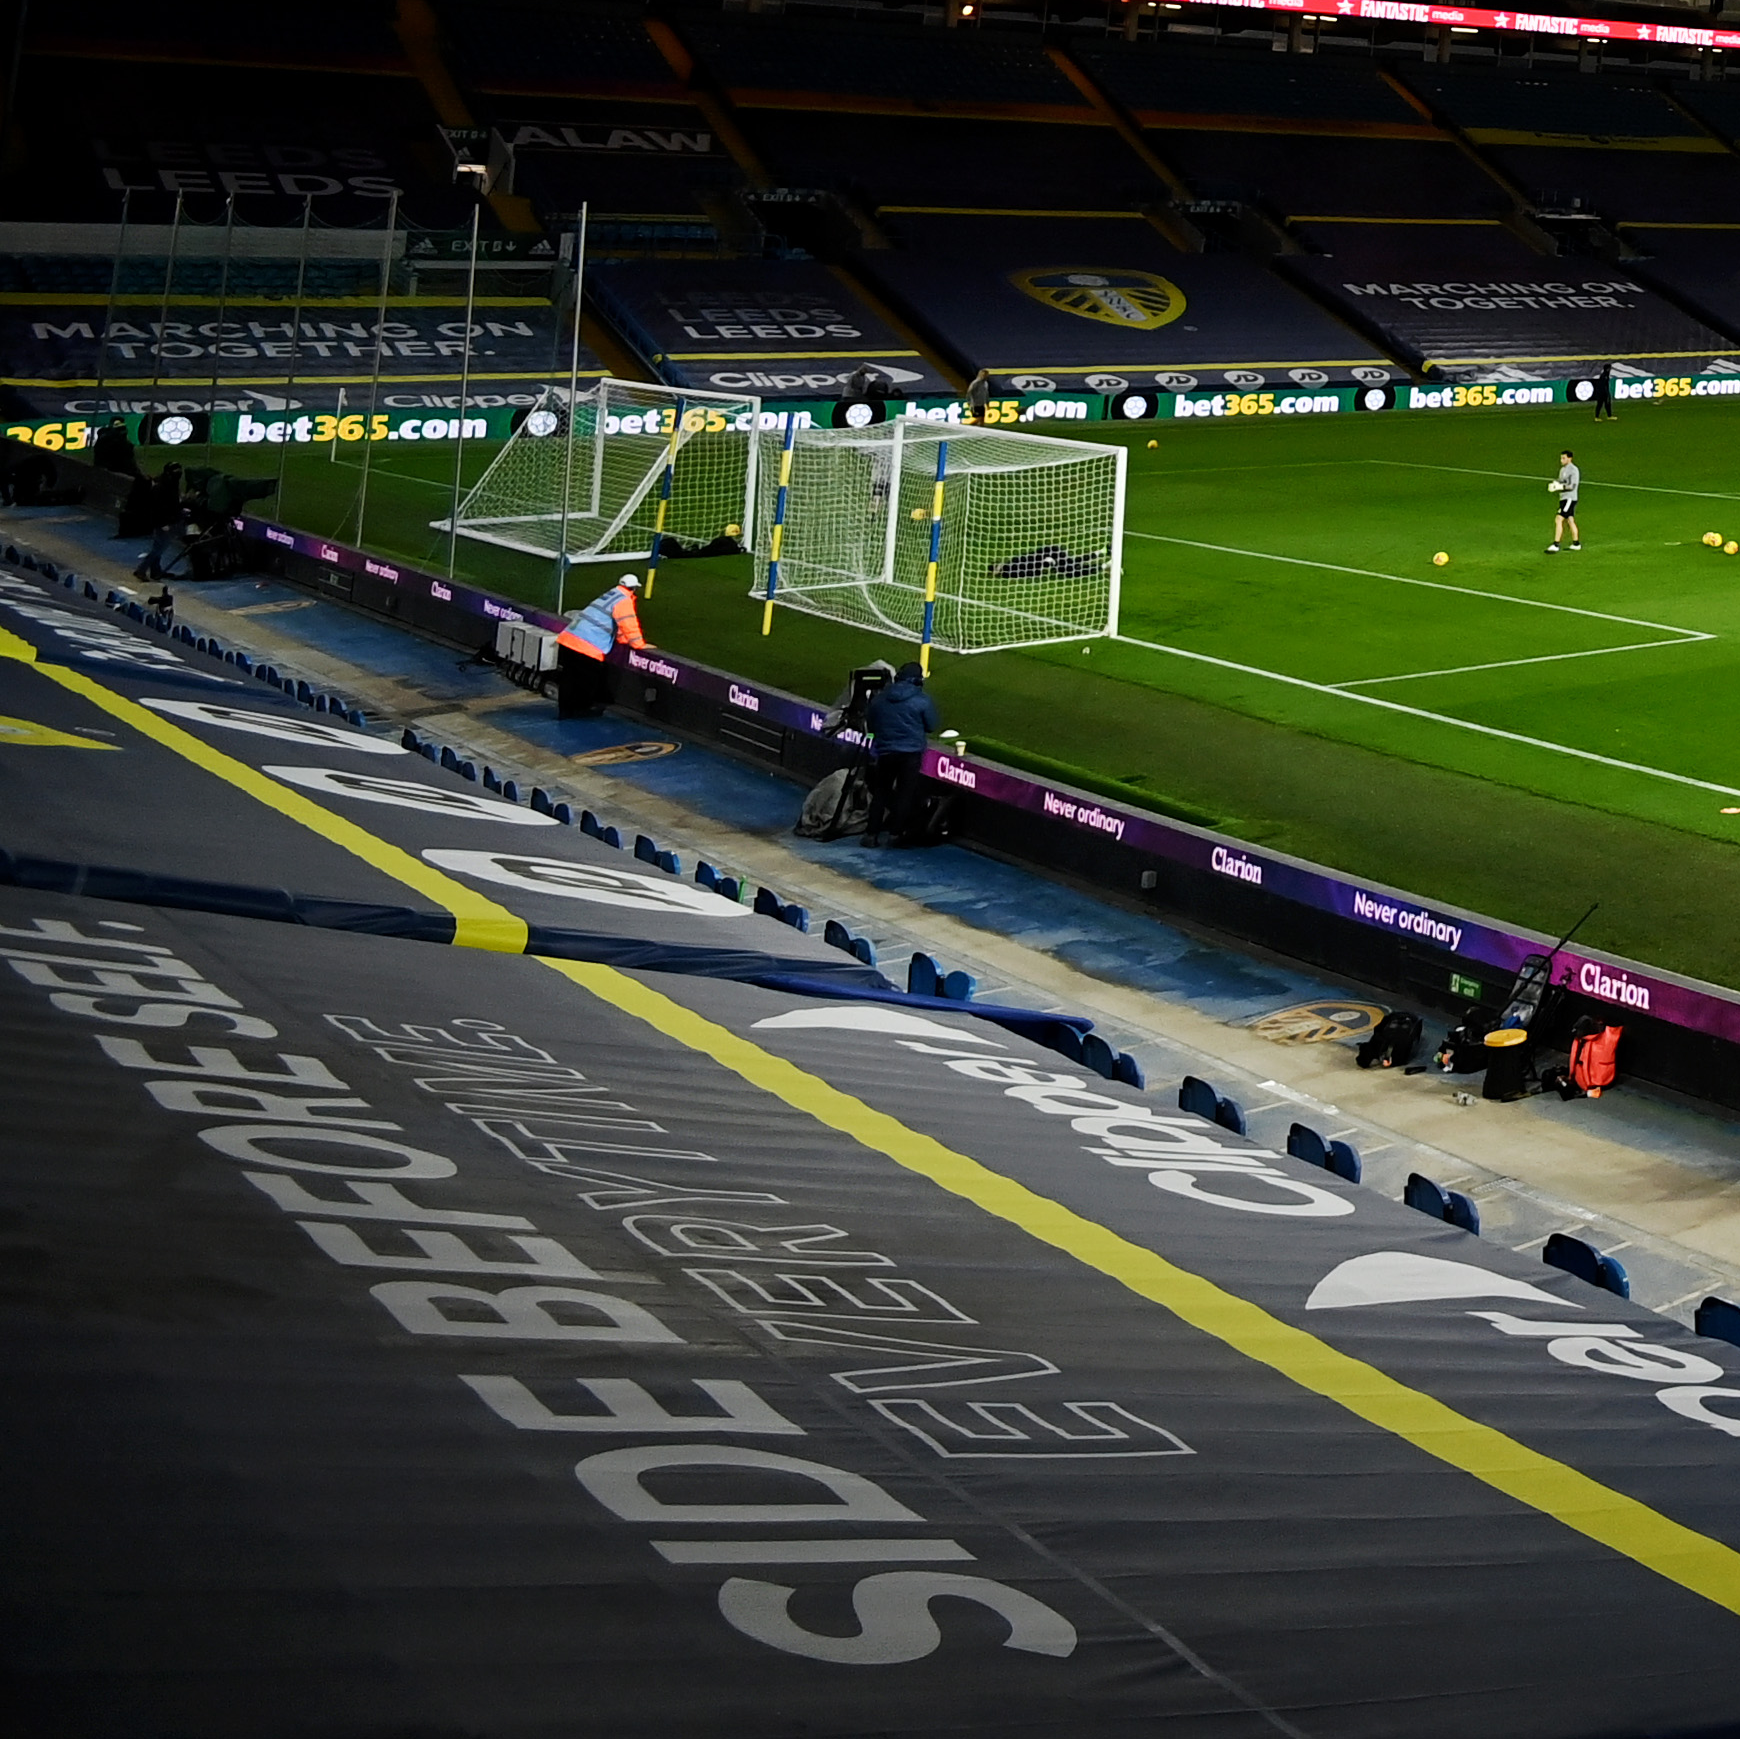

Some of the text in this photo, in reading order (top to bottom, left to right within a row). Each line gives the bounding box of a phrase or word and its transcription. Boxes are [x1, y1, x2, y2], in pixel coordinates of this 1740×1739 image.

[1360, 0, 1429, 23] FANTASTIC
[1515, 13, 1578, 35] FANTASTIC
[1656, 26, 1713, 46] FANTASTIC
[512, 125, 713, 153] ALAW
[102, 166, 405, 198] LEEDS
[451, 239, 490, 253] EXT
[1342, 281, 1645, 297] MARCHING ON
[1400, 295, 1636, 310] TOGETHER.
[667, 308, 846, 323] LEEDS
[31, 321, 534, 340] MARCHING ON
[683, 324, 863, 339] LEEDS
[106, 341, 496, 359] TOGETHER.
[1409, 384, 1554, 409] bet365.com
[1614, 375, 1740, 400] bet365.com
[1174, 392, 1340, 418] bet365.com
[236, 414, 488, 444] bet365.com
[628, 650, 679, 686] Never ordinary
[728, 684, 759, 712] Clarion
[936, 754, 977, 791] Clarion
[1042, 790, 1126, 842] Never ordinary
[1210, 844, 1263, 886] Clarion
[1353, 890, 1463, 952] Never ordinary
[1580, 959, 1651, 1012] Clarion
[894, 1039, 1357, 1218] Clipper
[93, 1034, 688, 1343] BEFORE
[459, 1372, 1080, 1665] SIDE
